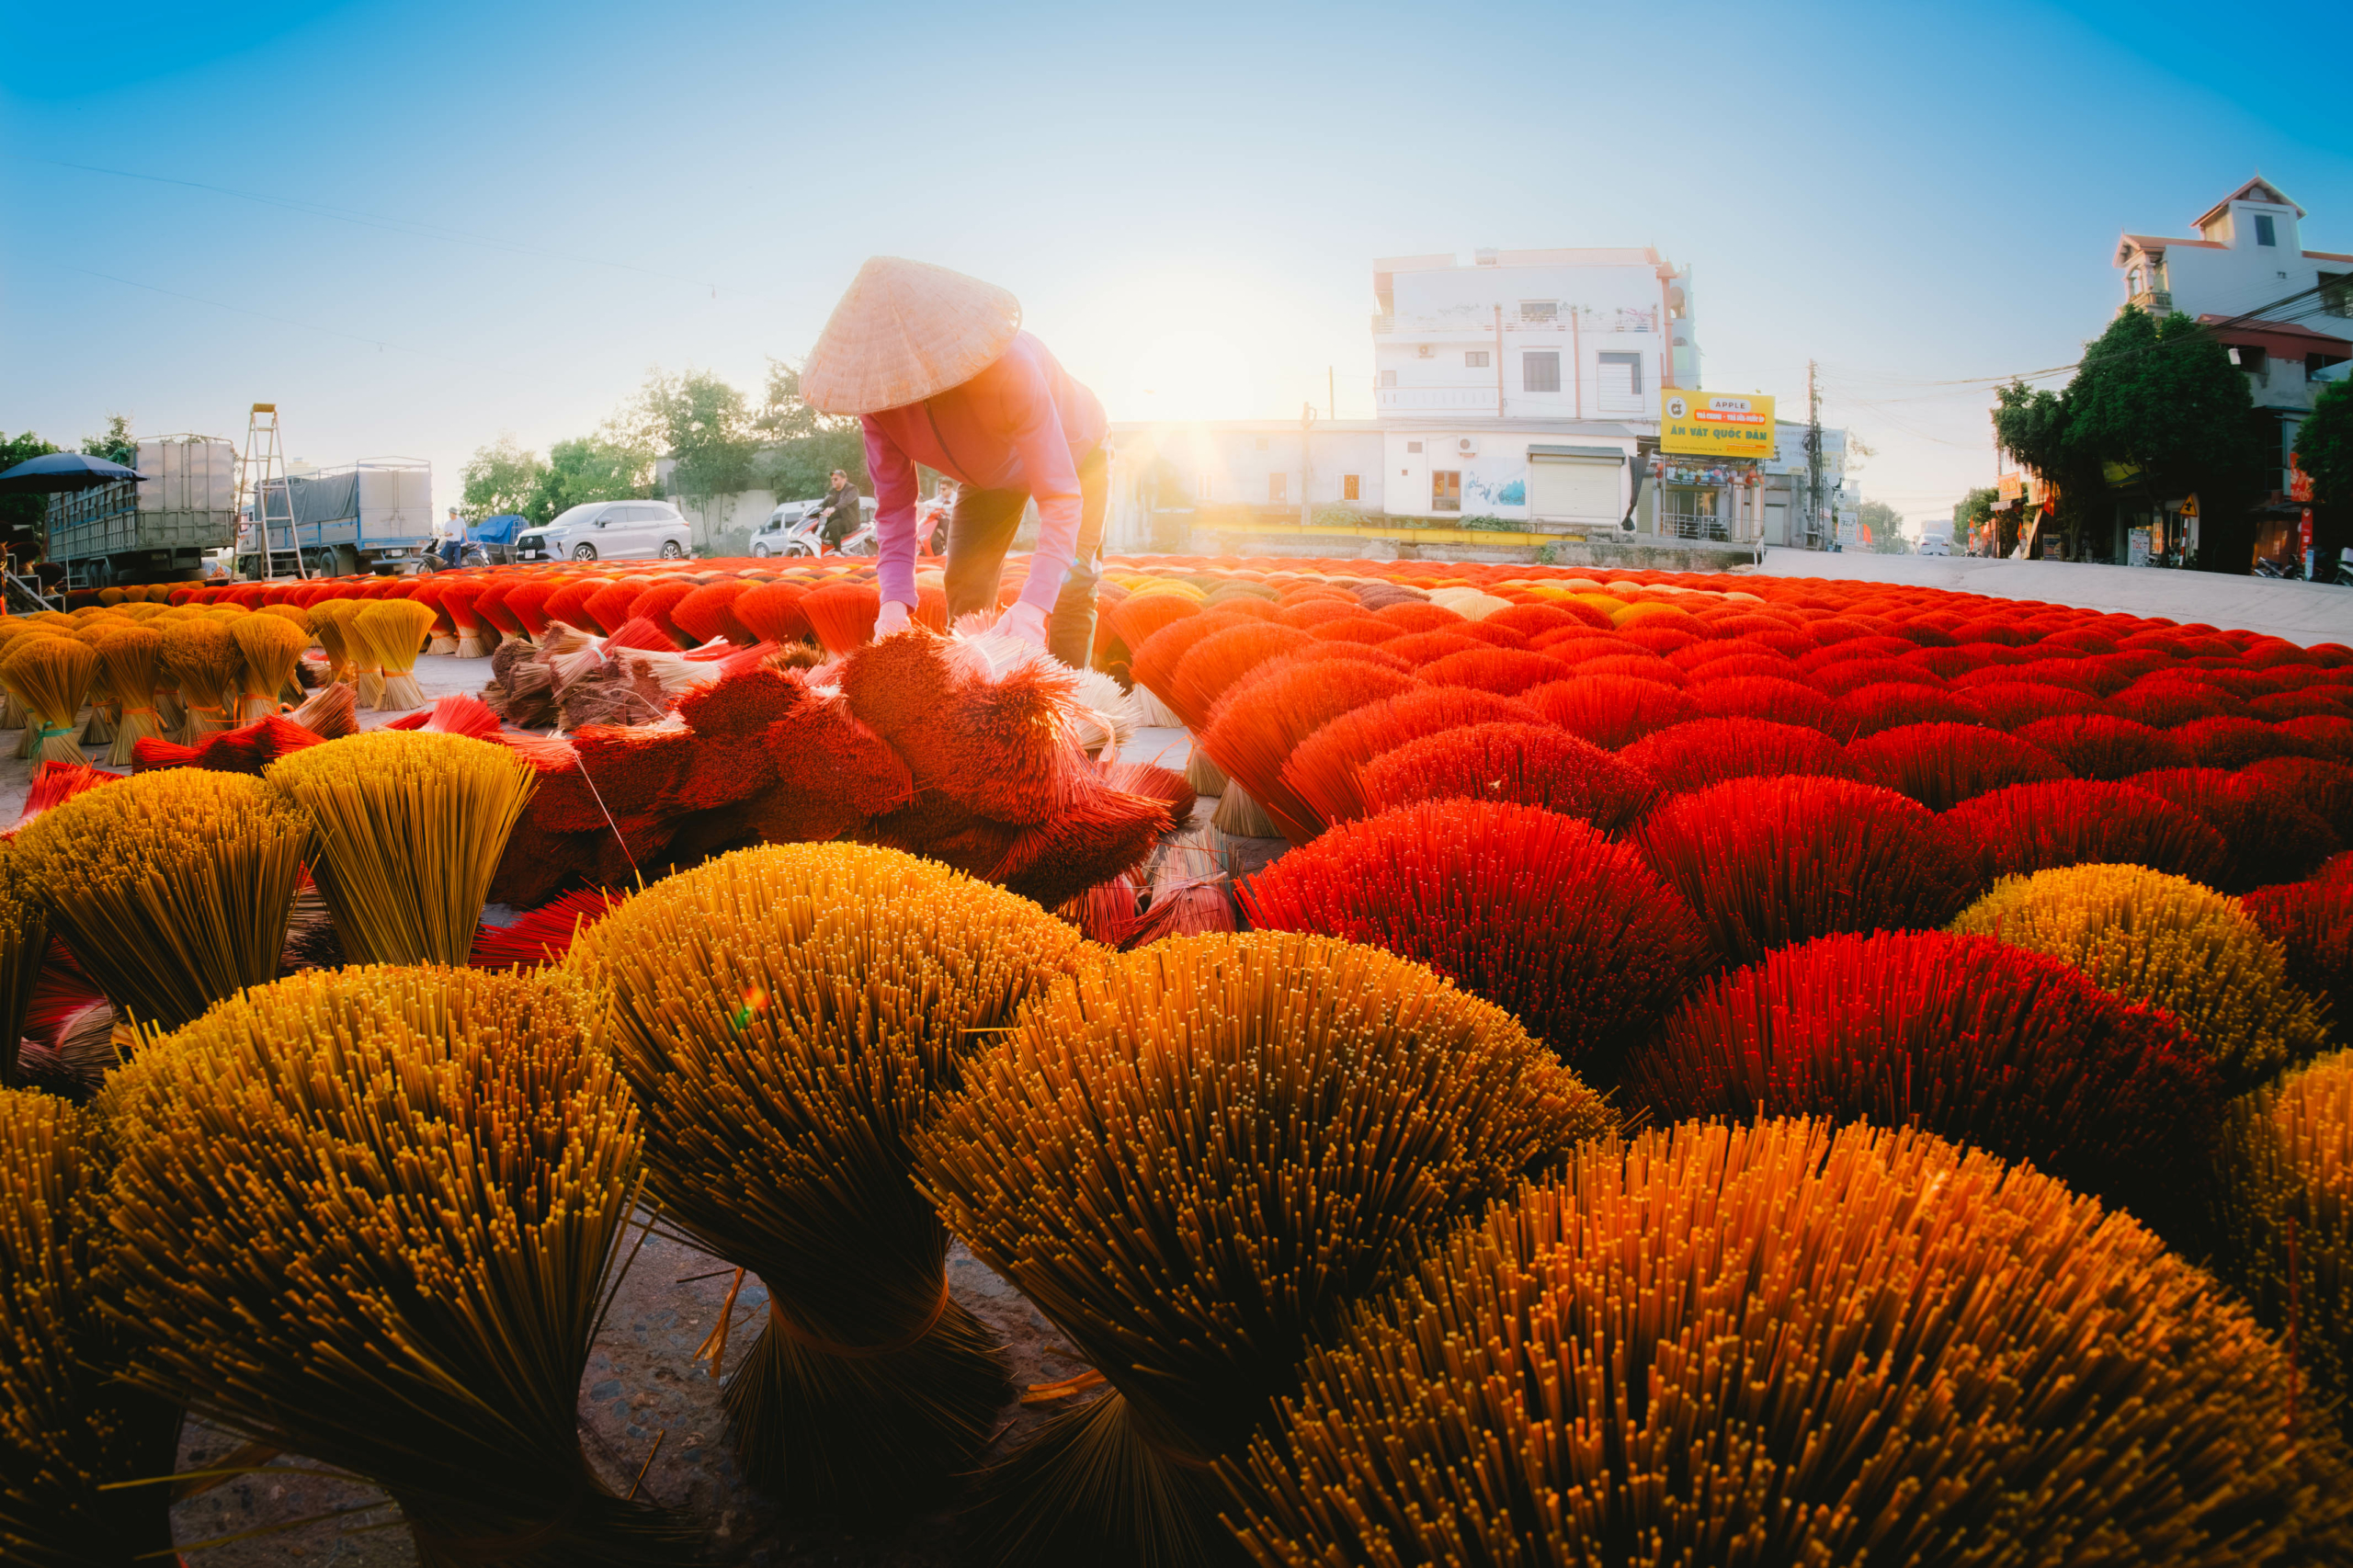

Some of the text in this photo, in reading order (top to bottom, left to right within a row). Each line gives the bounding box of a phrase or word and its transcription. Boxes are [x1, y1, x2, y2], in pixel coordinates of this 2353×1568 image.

[1715, 401, 1745, 409] APPLE
[1712, 426, 1742, 439] QUỐC
[1745, 429, 1767, 440] DÂN
